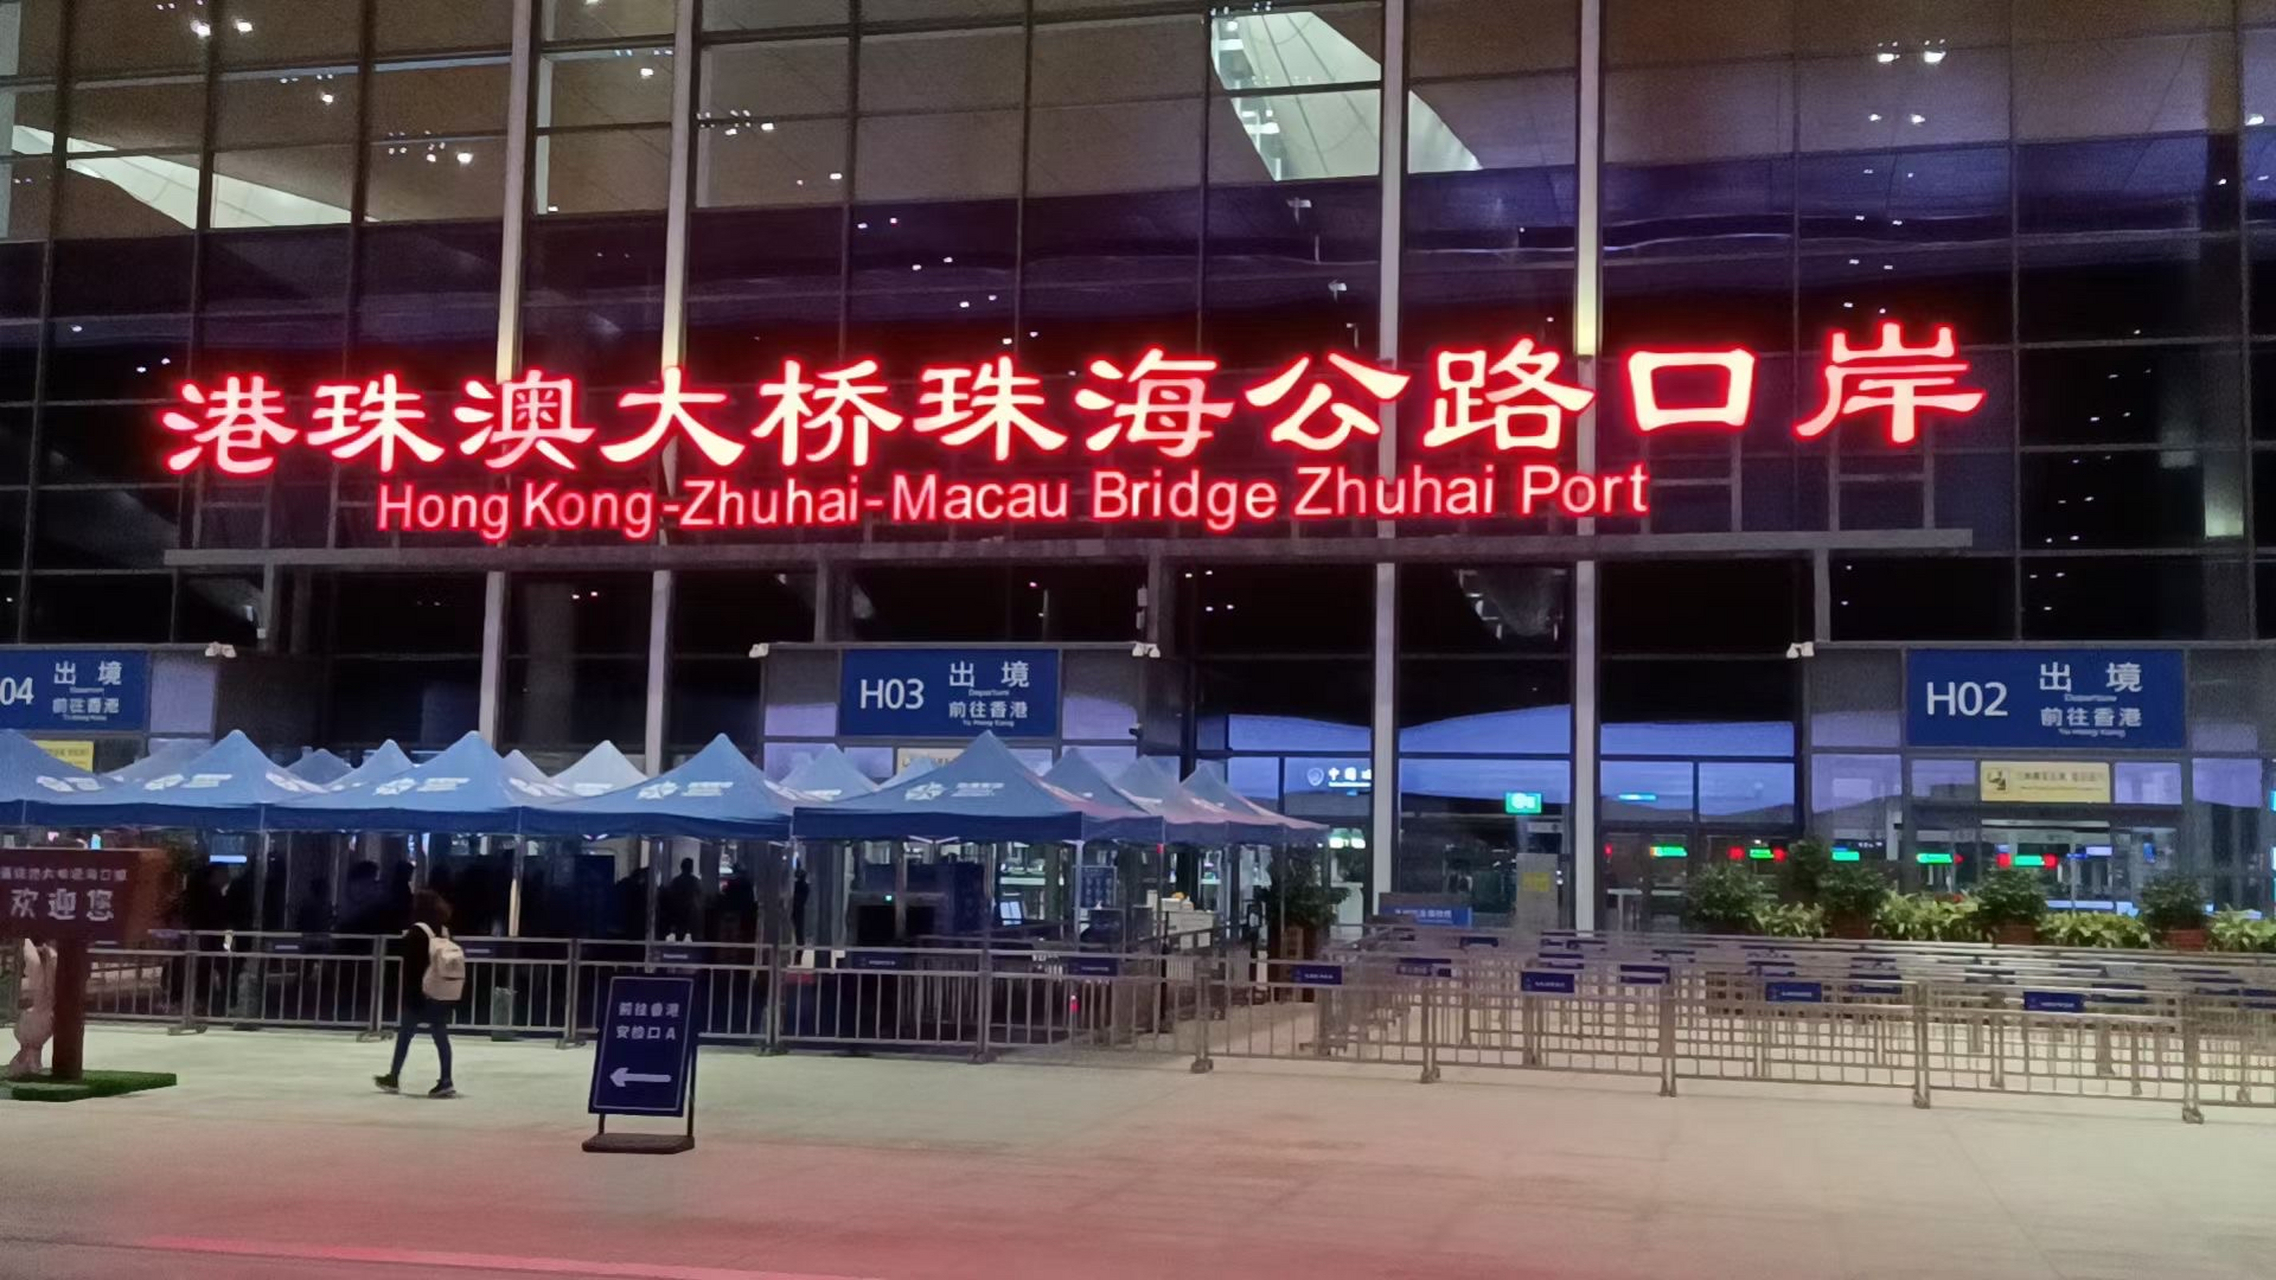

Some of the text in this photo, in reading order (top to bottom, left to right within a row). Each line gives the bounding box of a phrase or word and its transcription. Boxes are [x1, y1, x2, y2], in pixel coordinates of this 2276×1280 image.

[160, 320, 1984, 477] 港珠澳大桥珠海公路口岸
[378, 462, 1651, 542] Hong Kong-Zhuhai-Macau Bridge Zhuhai Port
[860, 678, 925, 710] H03
[949, 701, 1028, 719] 前往香港
[1926, 681, 2009, 717] H02
[2040, 707, 2142, 727] 前往香港
[10, 887, 115, 922] 欢迎您
